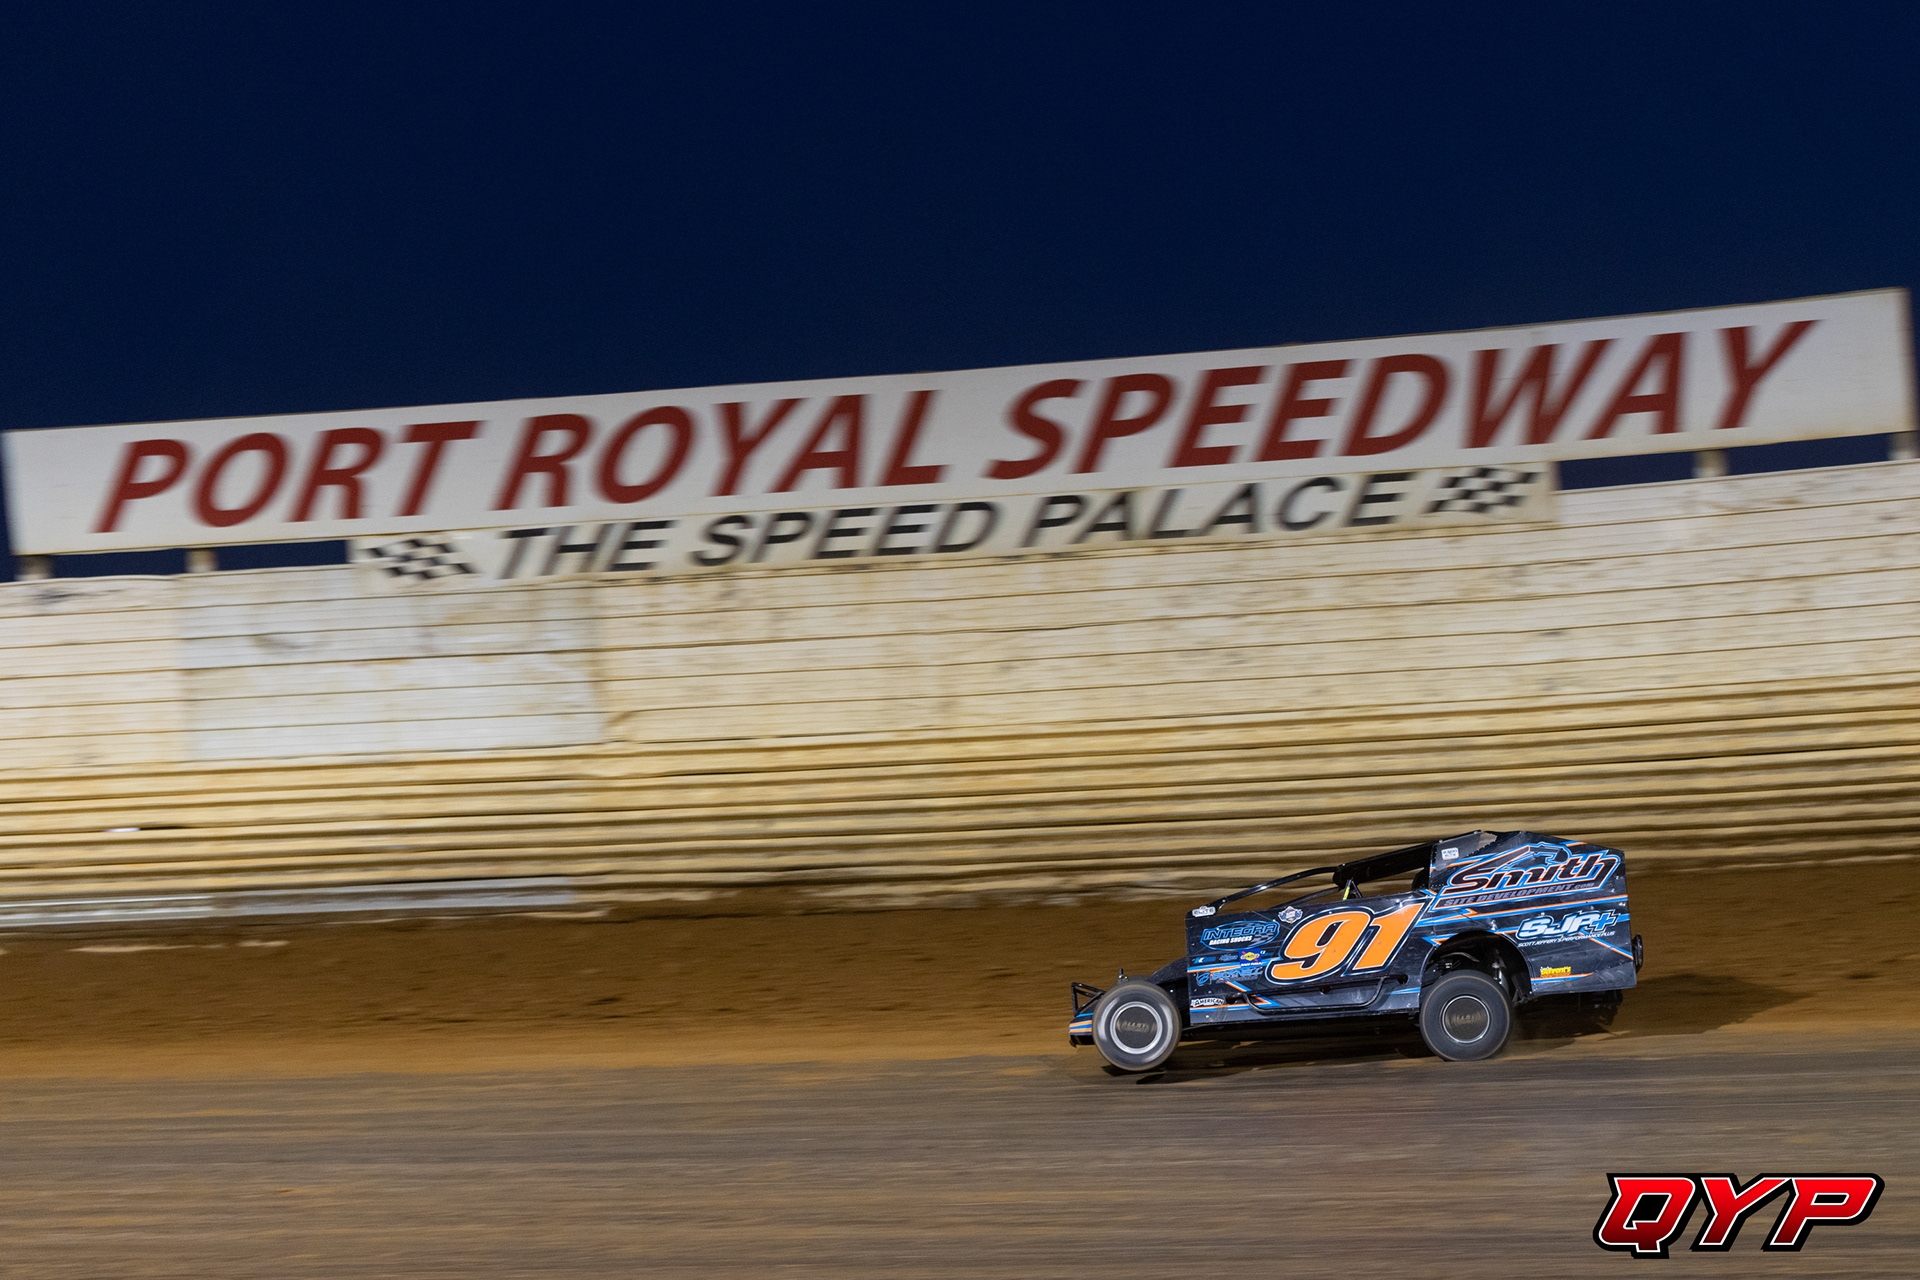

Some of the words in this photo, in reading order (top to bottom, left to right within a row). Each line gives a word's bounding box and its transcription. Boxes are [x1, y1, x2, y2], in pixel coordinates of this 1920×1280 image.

[90, 419, 488, 534] PORT
[491, 390, 946, 511] ROYAL
[981, 320, 1824, 480] SPEEDWAY
[496, 520, 678, 580] THE
[689, 501, 996, 568] SPEED
[1018, 471, 1416, 549] PALACE
[1442, 843, 1620, 897] Smith
[1443, 894, 1475, 907] SITE
[1203, 923, 1277, 941] INTEGRA
[1209, 937, 1230, 946] RACING
[1270, 902, 1426, 980] 91
